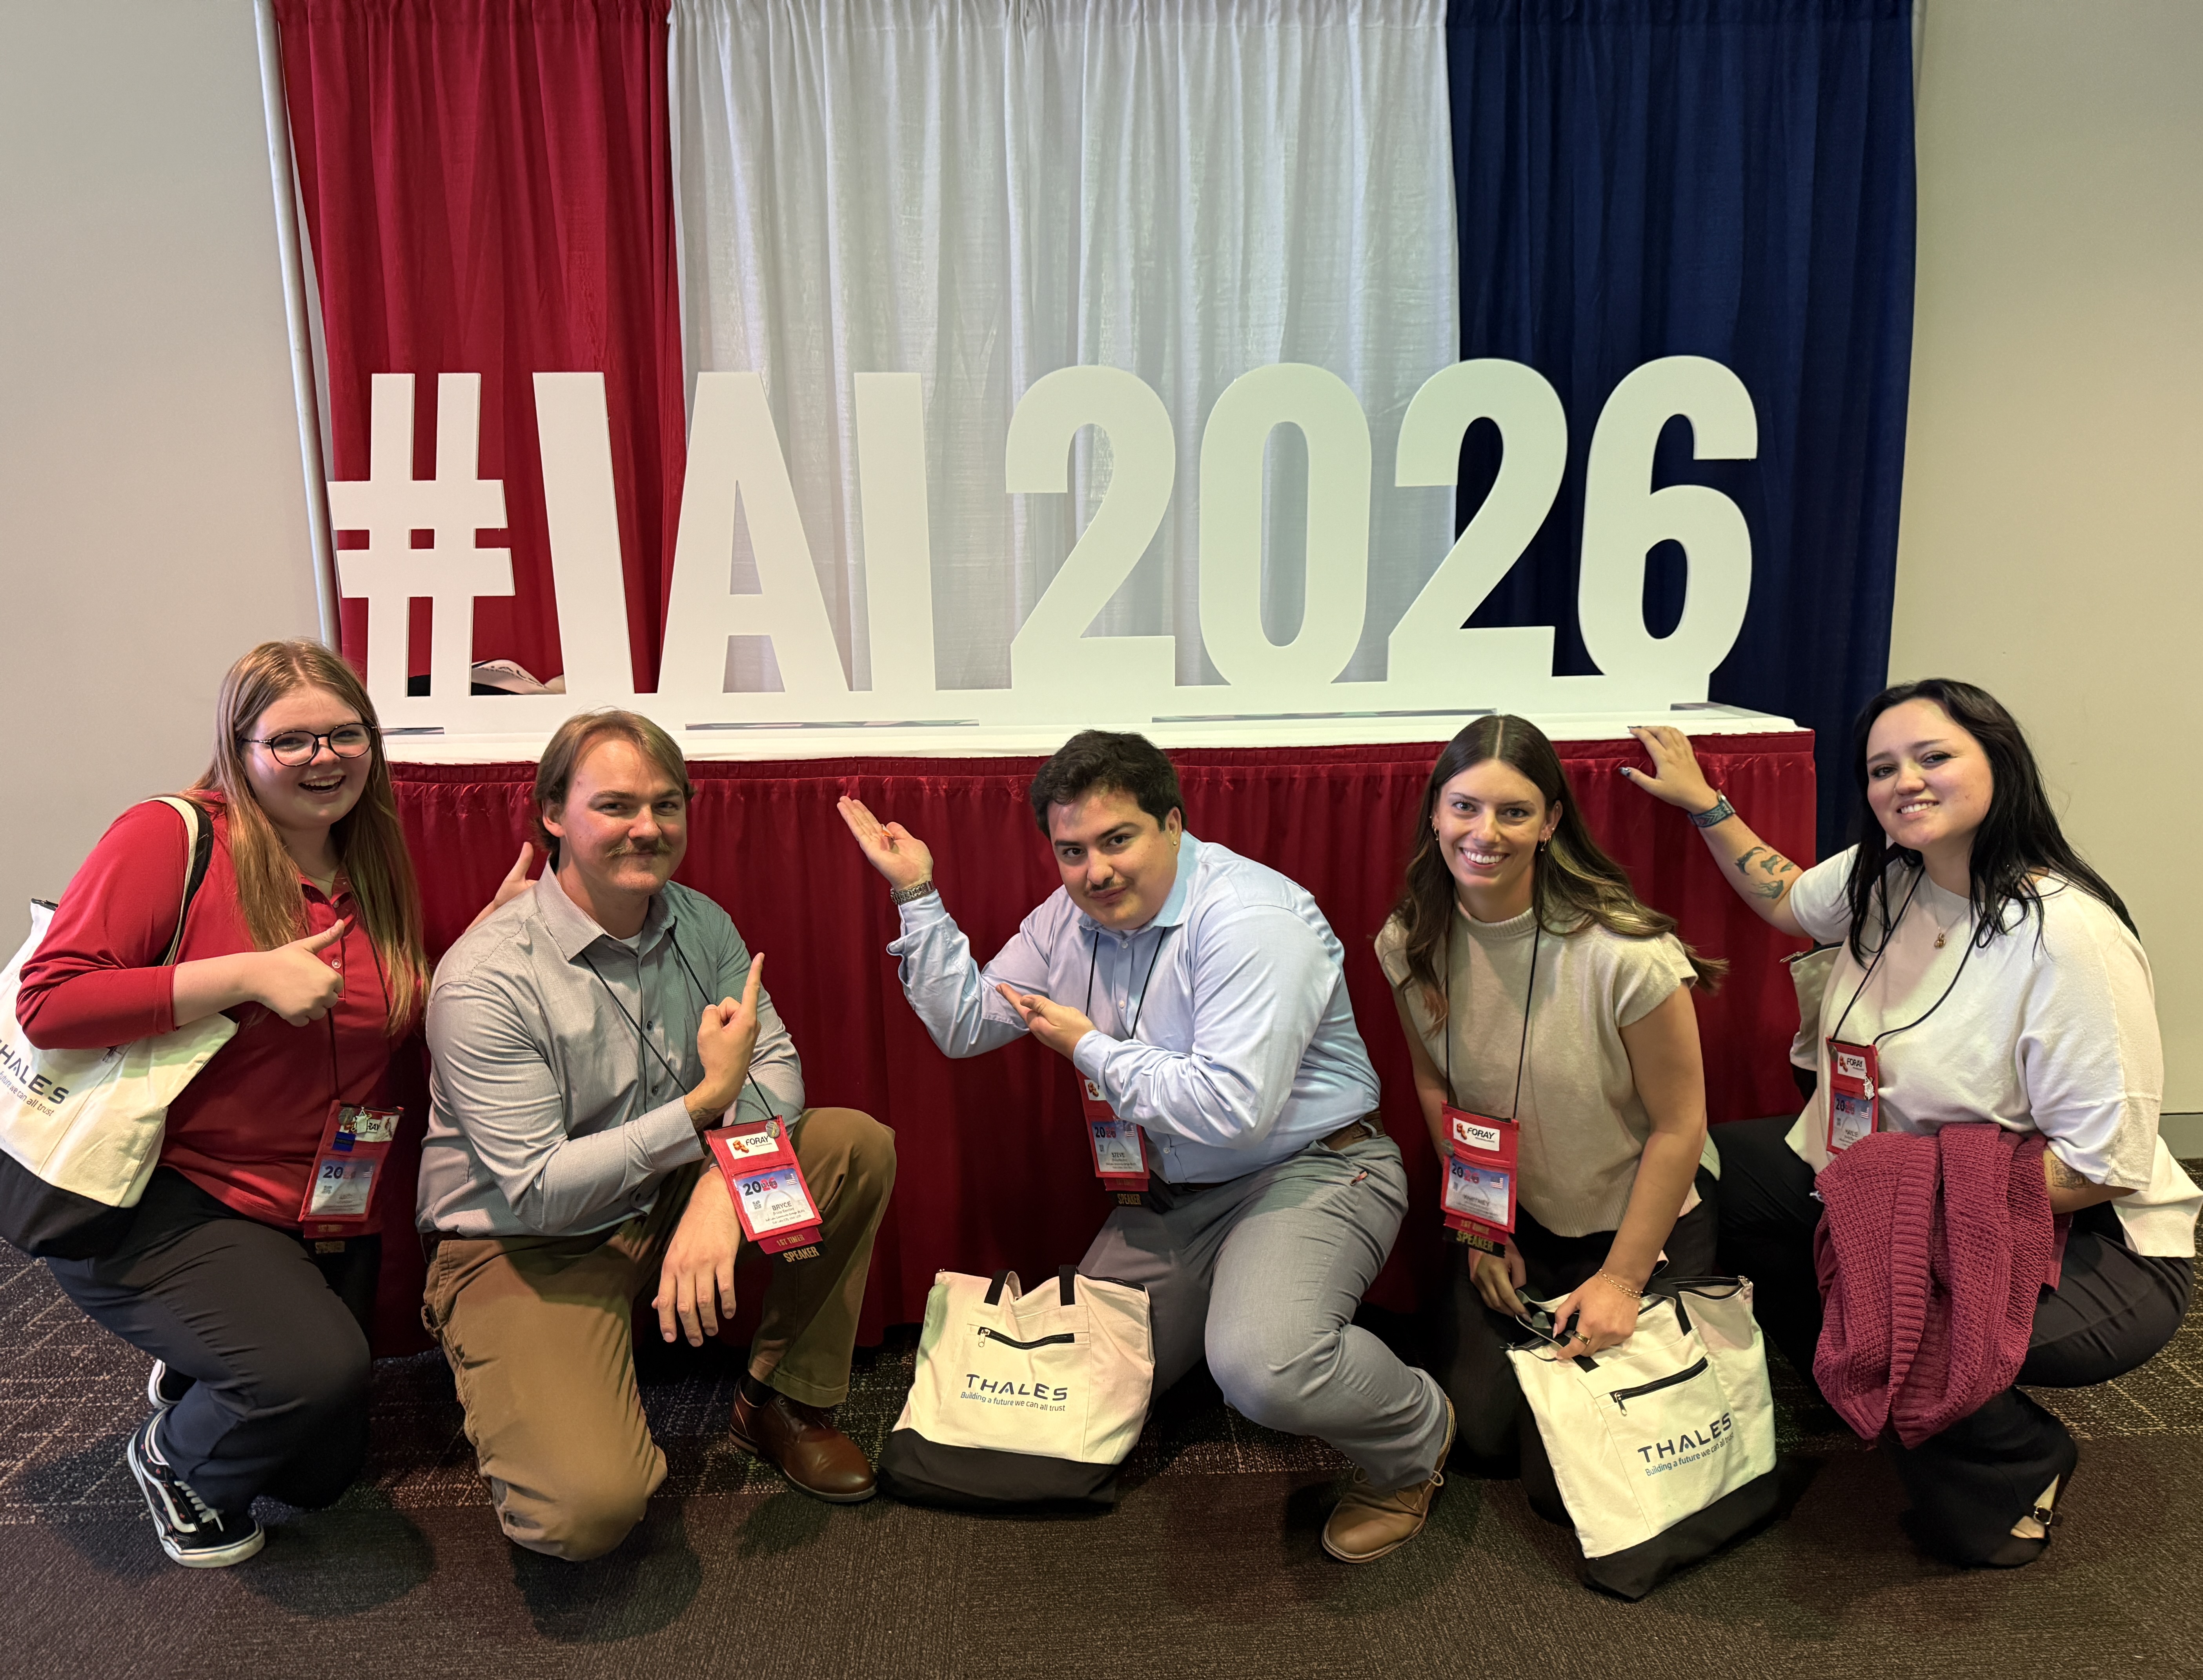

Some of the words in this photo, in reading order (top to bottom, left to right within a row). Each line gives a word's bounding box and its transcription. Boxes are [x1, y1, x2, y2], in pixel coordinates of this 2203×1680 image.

[1005, 355, 1758, 691] 2026
[0, 1038, 69, 1104] HALES
[1846, 1058, 1863, 1067] FORAY
[9, 1085, 18, 1094] we
[17, 1091, 27, 1102] can
[26, 1098, 38, 1108] all
[37, 1103, 54, 1116] trust
[745, 1135, 769, 1146] FORAY
[1467, 1127, 1495, 1140] FORAY
[1451, 1162, 1480, 1184] 2026
[742, 1176, 778, 1196] 2026
[771, 1201, 792, 1211] BRYCE
[1117, 1193, 1142, 1205] SPEAKER
[776, 1238, 788, 1247] 1ST
[787, 1234, 805, 1244] TIMER
[1456, 1230, 1494, 1253] SPEAKER
[783, 1246, 820, 1263] SPEAKER
[966, 1374, 1068, 1401] THALES
[960, 1391, 987, 1403] Building
[993, 1397, 1014, 1406] future
[1637, 1412, 1732, 1463] THALES
[1645, 1462, 1672, 1476] Building
[1679, 1453, 1700, 1465] future
[1700, 1449, 1711, 1457] we
[1711, 1443, 1720, 1453] can
